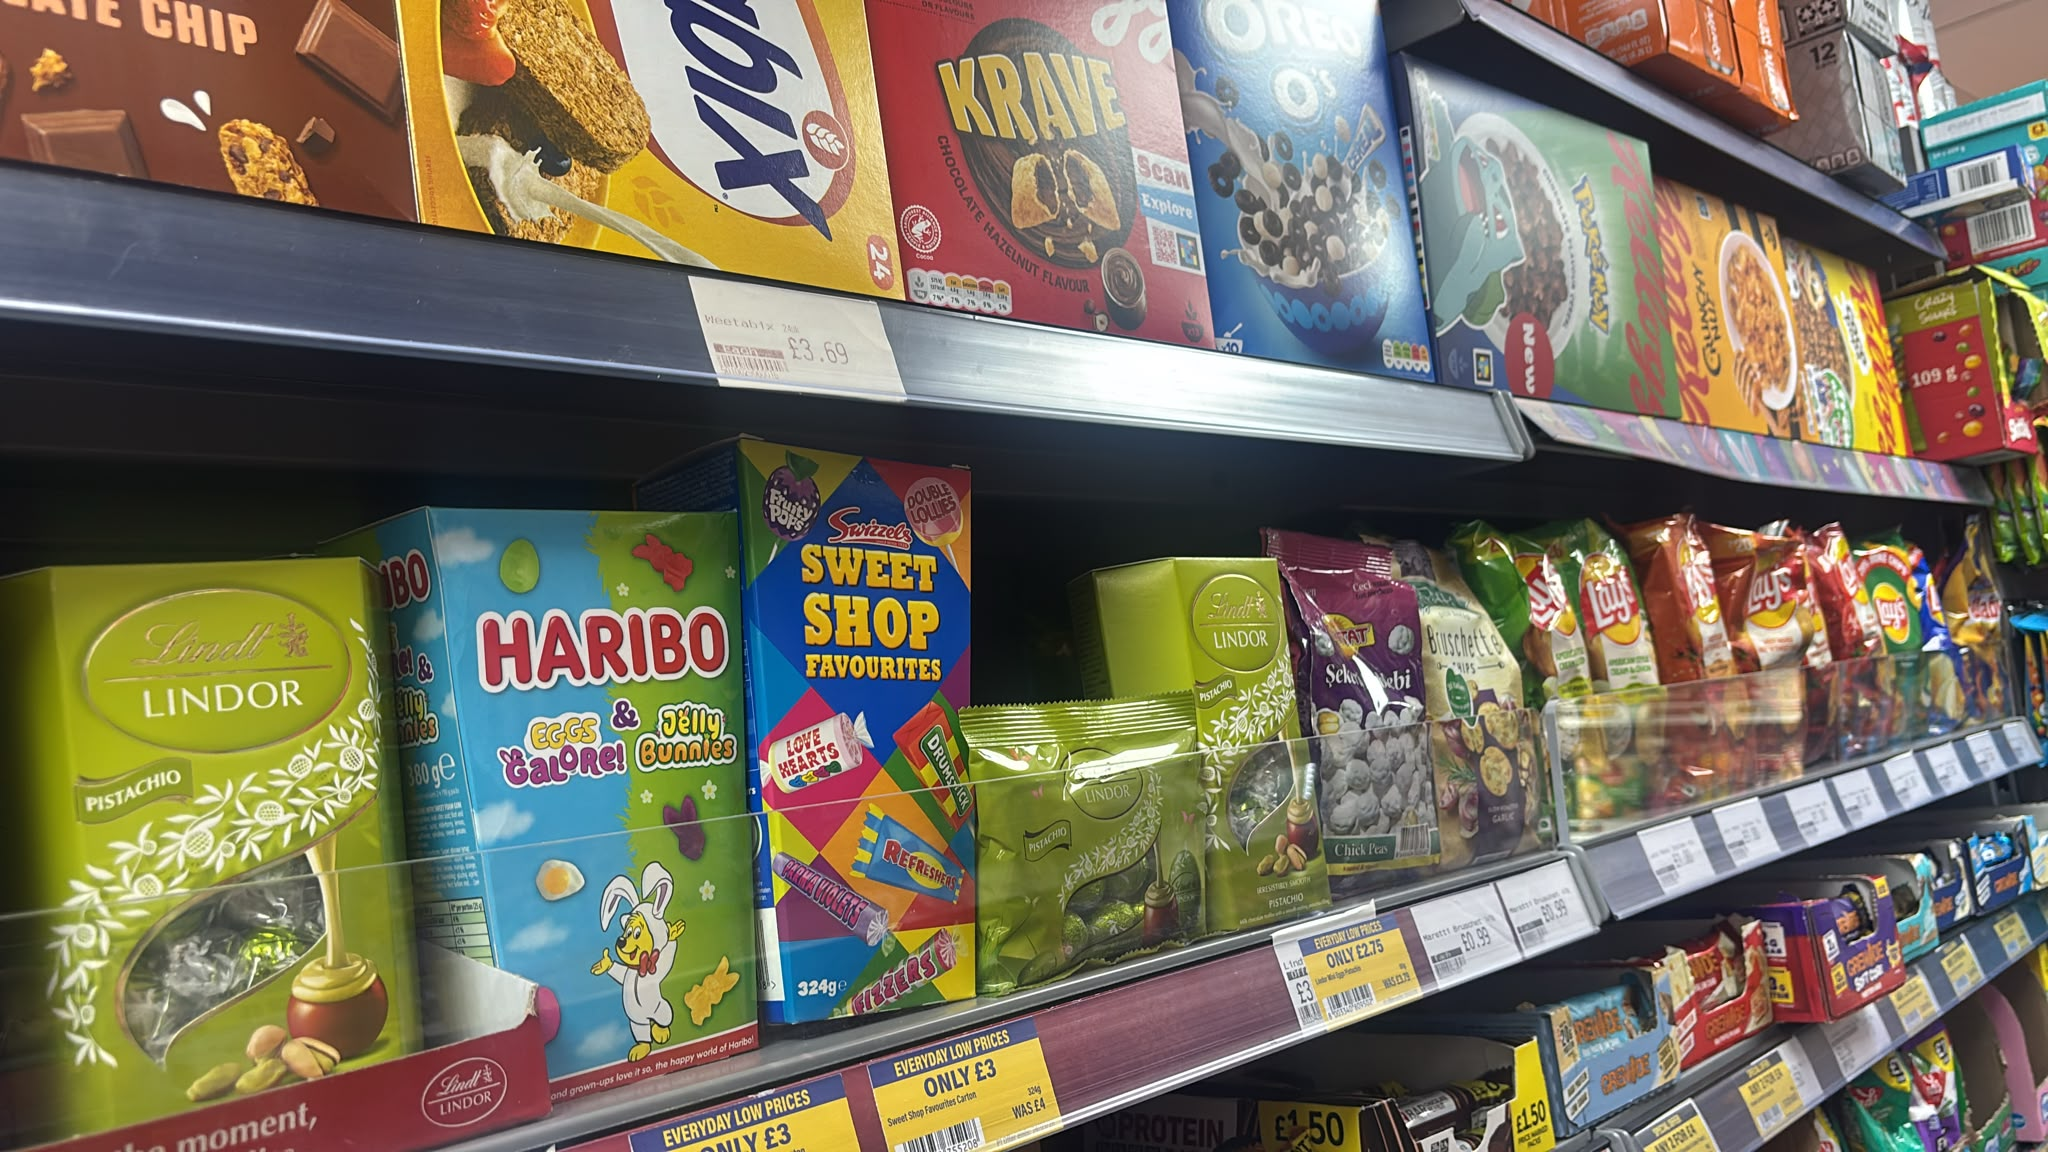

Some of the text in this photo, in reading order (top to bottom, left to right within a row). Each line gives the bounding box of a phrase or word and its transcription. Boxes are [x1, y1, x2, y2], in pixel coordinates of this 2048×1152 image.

[140, 0, 258, 56] CHIP
[1206, 0, 1362, 60] OREO
[1810, 41, 1837, 64] 12
[937, 52, 1127, 140] KRAVE
[1137, 155, 1190, 191] Scan
[937, 135, 1091, 293] CHOCOLATE HAZELNUT FLAVOUR
[1141, 191, 1194, 220] Explore
[869, 245, 891, 281] 24
[704, 314, 775, 331] Weetabix
[788, 336, 849, 365] £3.69
[1522, 322, 1536, 395] New
[1911, 365, 1958, 389] 109 g
[769, 489, 814, 519] Fruity
[908, 483, 952, 508] DOUBLE
[911, 496, 957, 525] LOLLIES
[829, 507, 913, 545] Swizzels
[384, 552, 429, 608] IBO
[801, 544, 938, 592] SWEET
[1352, 580, 1372, 592] Ceci
[803, 592, 940, 650] SHOP
[1208, 593, 1254, 619] Lindt
[131, 612, 274, 667] Lindt
[480, 610, 728, 690] HARIBO
[1213, 630, 1269, 650] LINDOR
[1427, 624, 1502, 658] Bruschette
[805, 654, 942, 681] FAVOURITES
[143, 679, 304, 719] LINDOR
[395, 688, 427, 718] elly
[1199, 679, 1233, 702] PISTACHIO
[612, 700, 639, 729] &
[661, 706, 720, 739] Jelly
[530, 717, 598, 749] EGGS
[786, 728, 822, 758] LOVE
[639, 738, 734, 767] Bunnies
[777, 742, 840, 778] HEARTS
[926, 732, 970, 813] DRUMSTICK
[85, 768, 182, 813] PISTACHIO
[1085, 783, 1131, 803] LINDOR
[1492, 814, 1515, 823] GARLIC
[1028, 827, 1068, 853] PISTACHIO
[1334, 842, 1388, 857] Chick Peas
[883, 839, 957, 890] REFRESHERS
[781, 860, 818, 887] PARMA
[813, 875, 870, 930] VIOLETS
[1257, 877, 1311, 894] IRRESISTIBLY SMOOTH
[1268, 893, 1304, 908] PISTACHIO
[1540, 898, 1568, 923] £0.99
[1314, 920, 1383, 950] EVERYDAY LOW PRICES
[1423, 928, 1449, 942] Maretti
[1461, 926, 1491, 952] £0.99
[1283, 958, 1304, 971] Lind
[1326, 939, 1384, 969] ONLY £2.75
[852, 948, 937, 1015] FIZZERS
[1382, 977, 1396, 989] WAS
[551, 1035, 754, 1101] and grown-ups love it so, the happy world of Haribo!
[893, 1030, 1010, 1078] EVERYDAY LOW PRICES
[438, 1069, 483, 1098] Lindt
[923, 1058, 997, 1098] ONLY £3
[1028, 1085, 1042, 1097] 324g
[438, 1089, 493, 1117] LINDOR
[887, 1091, 977, 1127] Sweet Shop Favourites Carton
[1012, 1097, 1046, 1119] WAS £4
[1516, 1100, 1547, 1134] £1.50
[662, 1089, 811, 1148] EVERYDAY LOW PRICES
[1118, 1112, 1225, 1148] PROTEIN
[764, 1124, 792, 1150] £3
[1518, 1133, 1531, 1144] PRICE
[1527, 1137, 1542, 1148] PACKS
